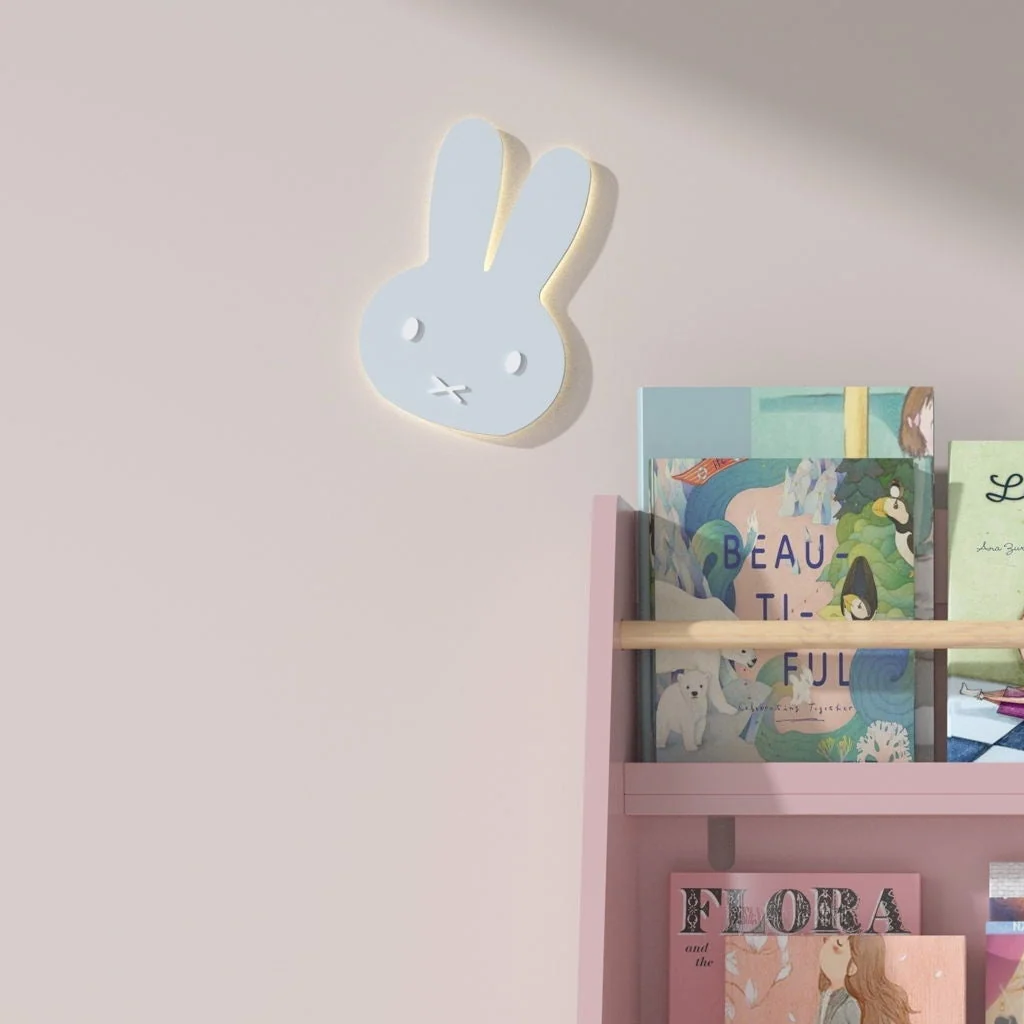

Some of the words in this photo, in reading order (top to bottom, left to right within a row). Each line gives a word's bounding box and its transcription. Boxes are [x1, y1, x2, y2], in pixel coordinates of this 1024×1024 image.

[976, 541, 1003, 553] Ana
[784, 652, 850, 687] FUL
[677, 887, 912, 936] FLORA
[684, 942, 709, 953] and
[695, 956, 714, 967] the
